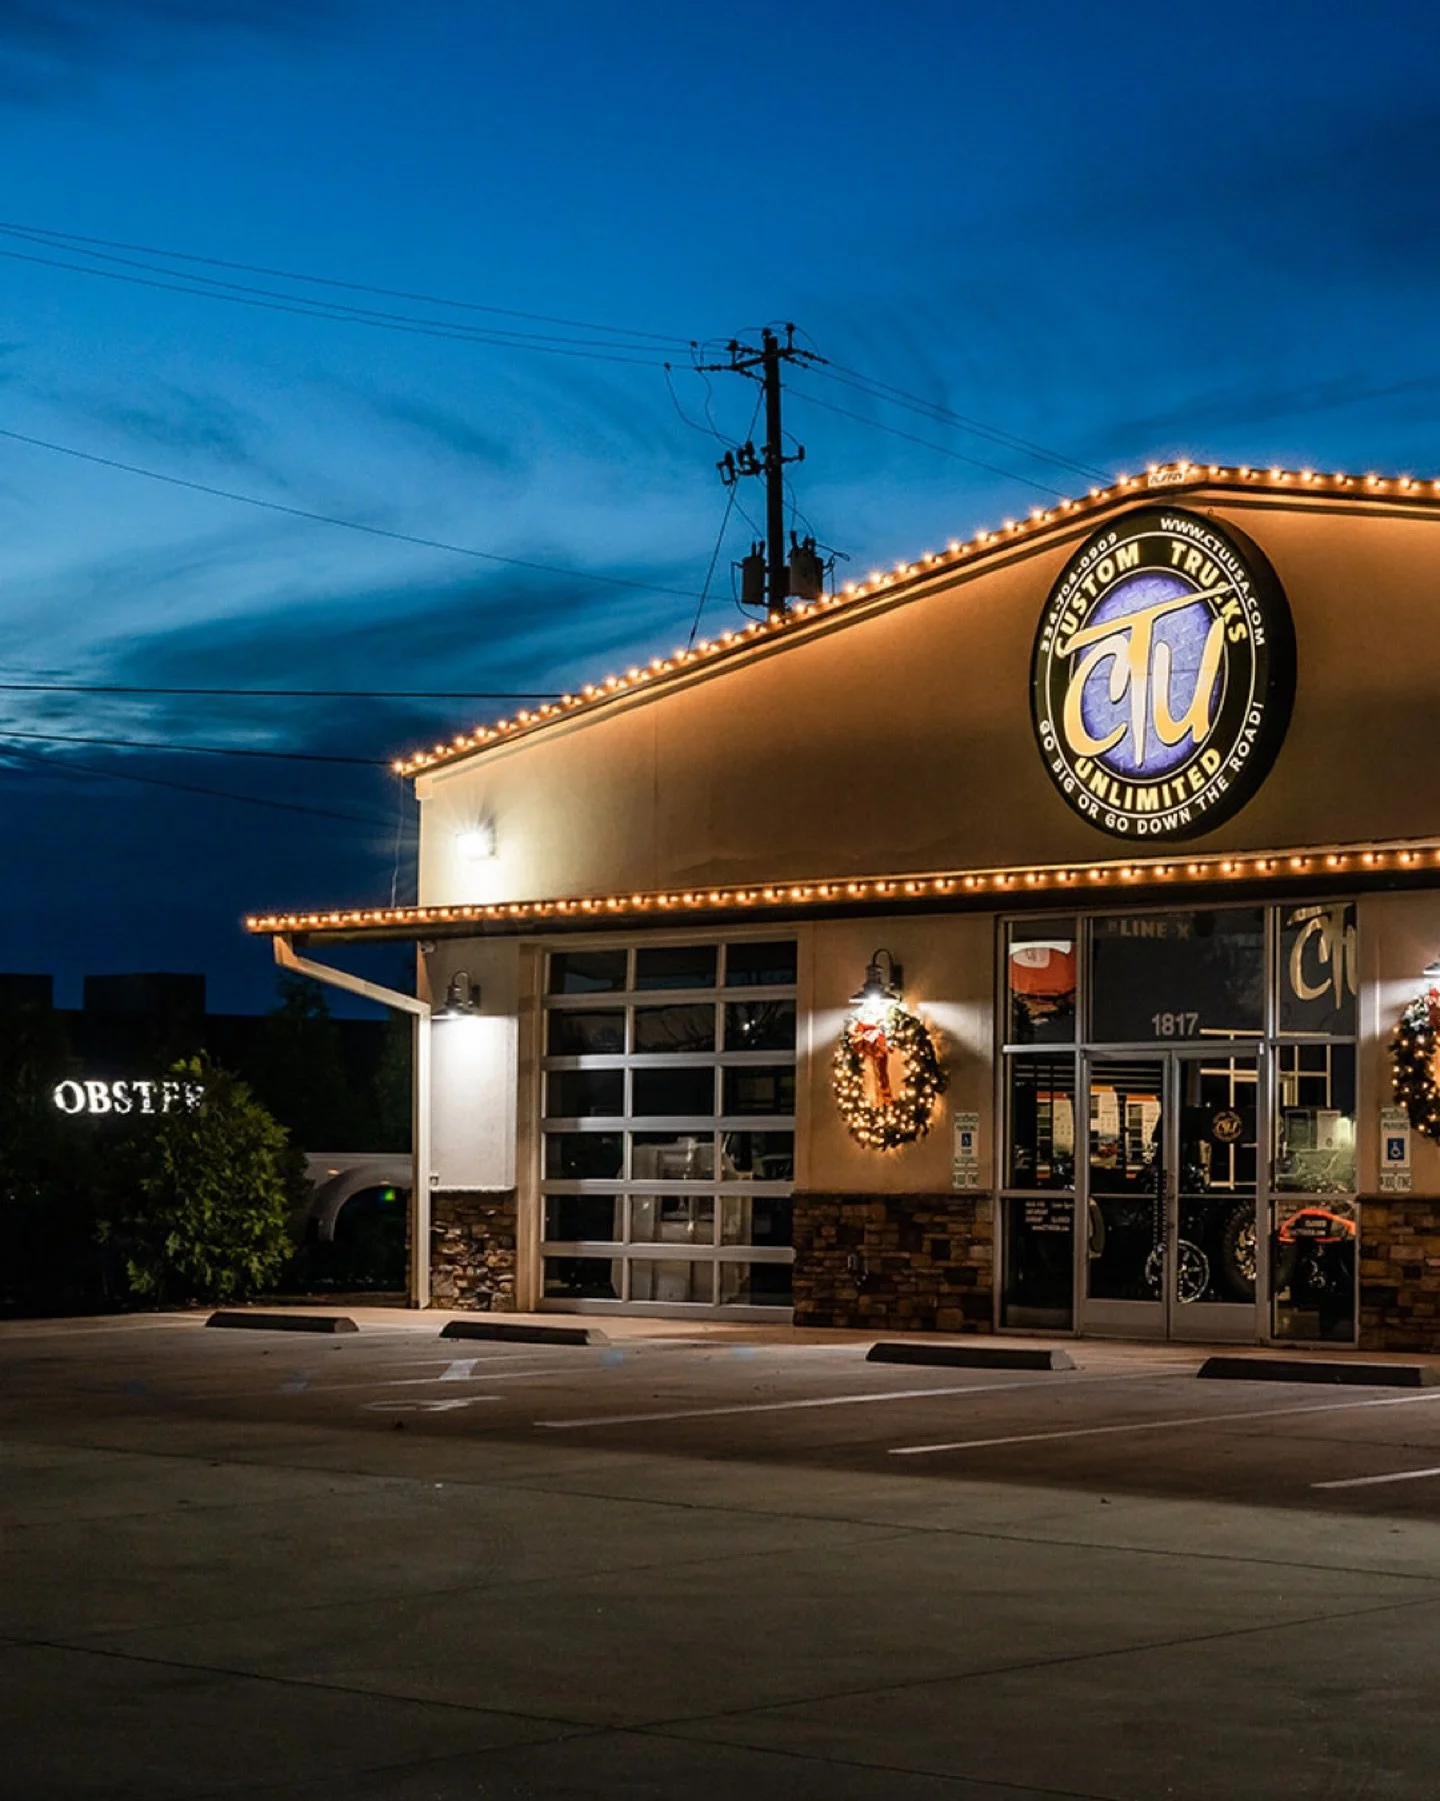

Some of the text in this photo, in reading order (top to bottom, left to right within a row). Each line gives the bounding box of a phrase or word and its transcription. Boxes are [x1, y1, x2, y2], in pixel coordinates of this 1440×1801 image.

[1055, 541, 1140, 659] CUSTOM
[1160, 517, 1265, 646] WWW.CTUUSA.COM
[1063, 584, 1236, 768] CTU
[1039, 719, 1055, 751] GO
[1052, 758, 1076, 793] BIG
[1078, 793, 1100, 819] OR
[1104, 813, 1129, 832] GO
[1137, 807, 1192, 835] DOWN
[1195, 775, 1230, 811] THE
[1074, 748, 1221, 812] UNLIMITED
[1151, 1012, 1199, 1037] 1817
